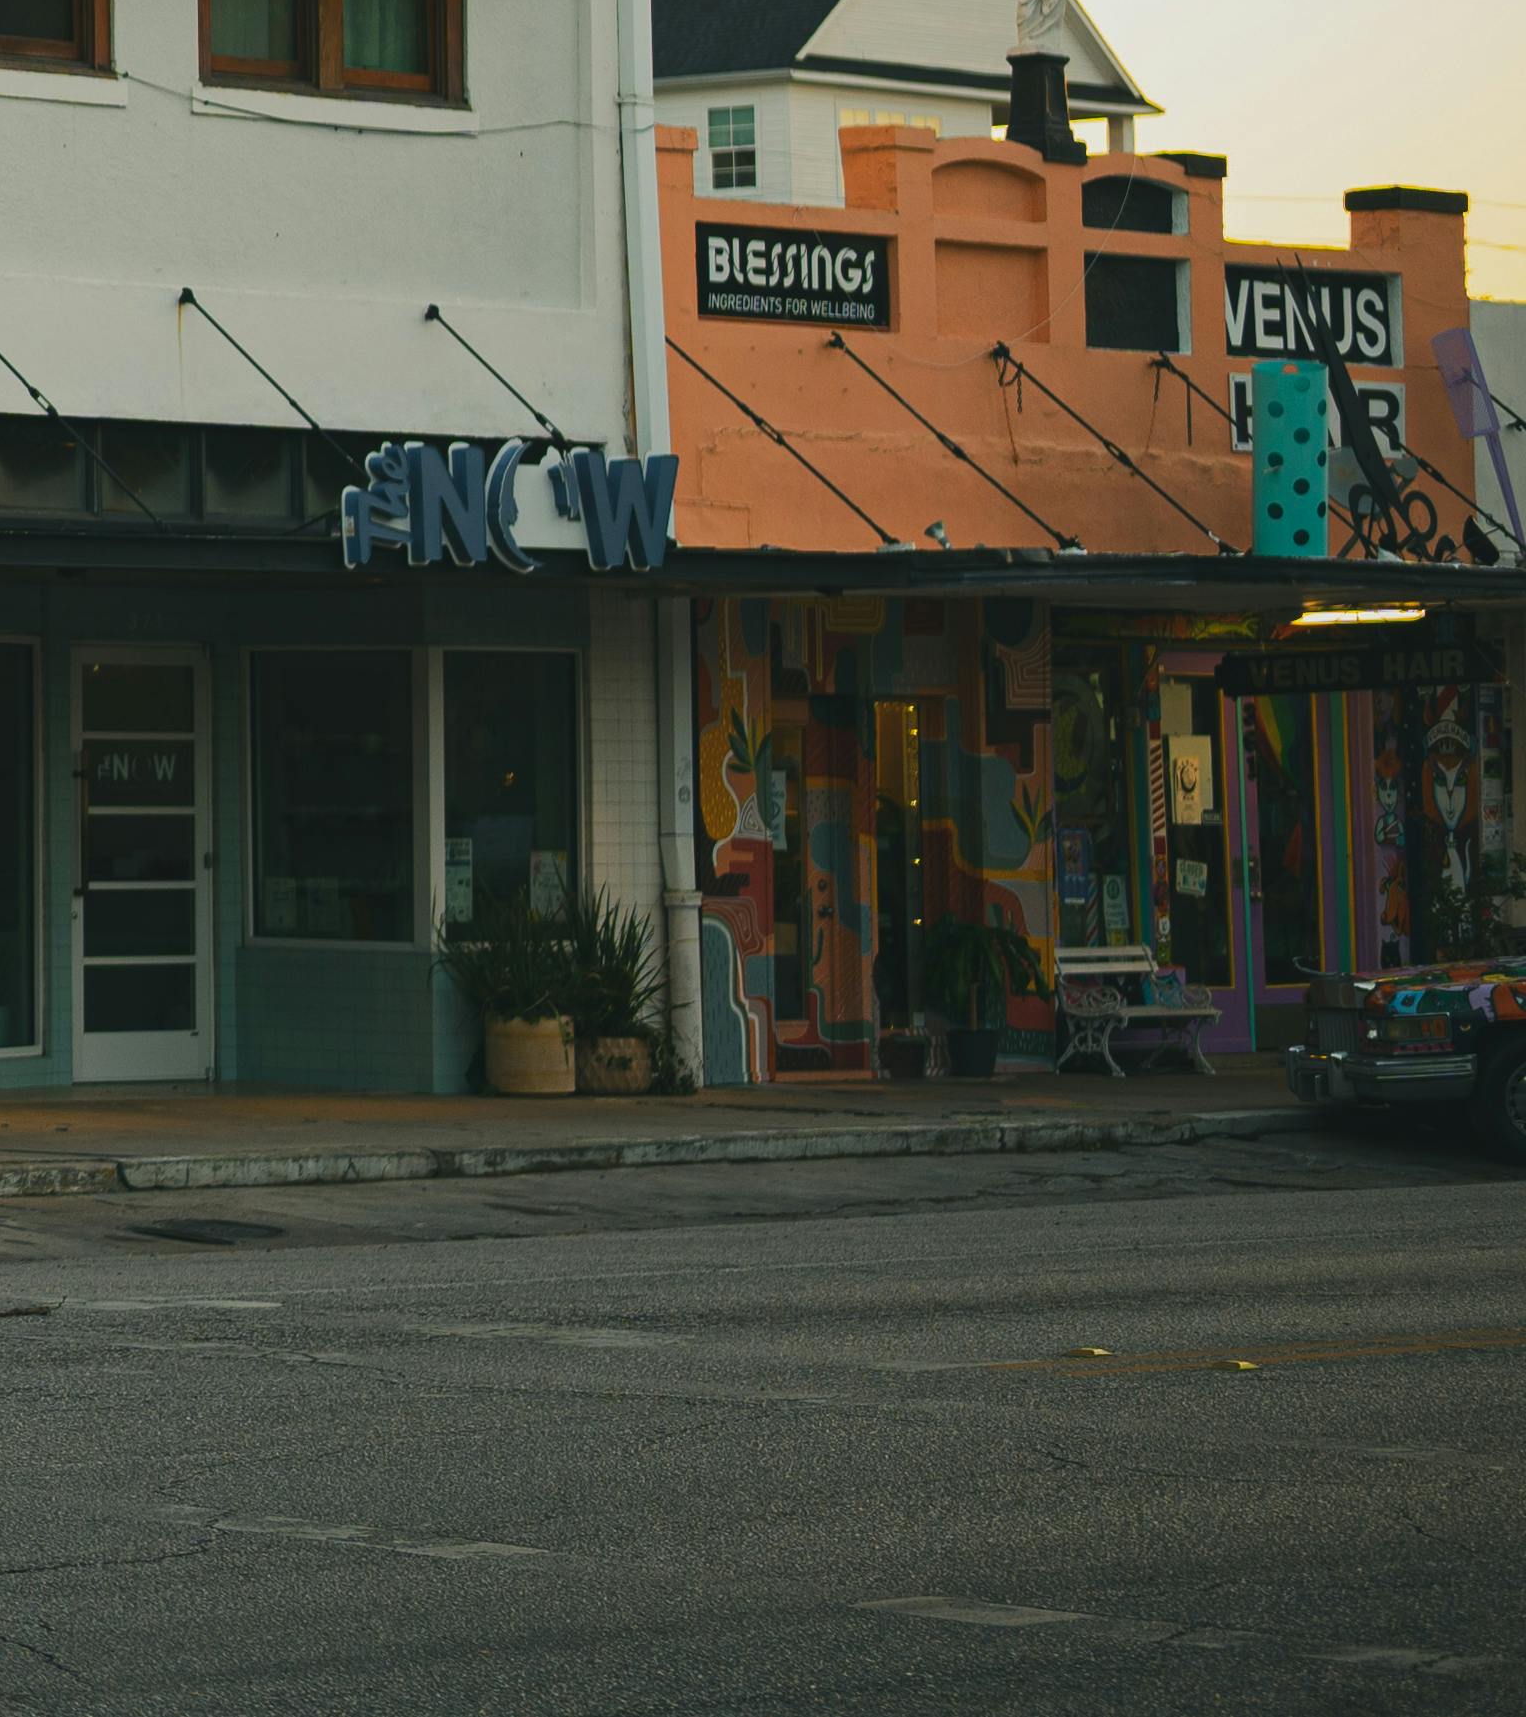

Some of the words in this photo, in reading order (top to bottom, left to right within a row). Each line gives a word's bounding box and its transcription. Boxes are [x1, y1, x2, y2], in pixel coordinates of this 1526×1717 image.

[707, 236, 875, 294] BLESSINGS
[708, 292, 783, 315] INGREDIENTS
[785, 298, 808, 316] FOR
[810, 300, 875, 320] WELLBEING
[1248, 656, 1361, 686] VENUS
[1382, 648, 1466, 681] HAIR
